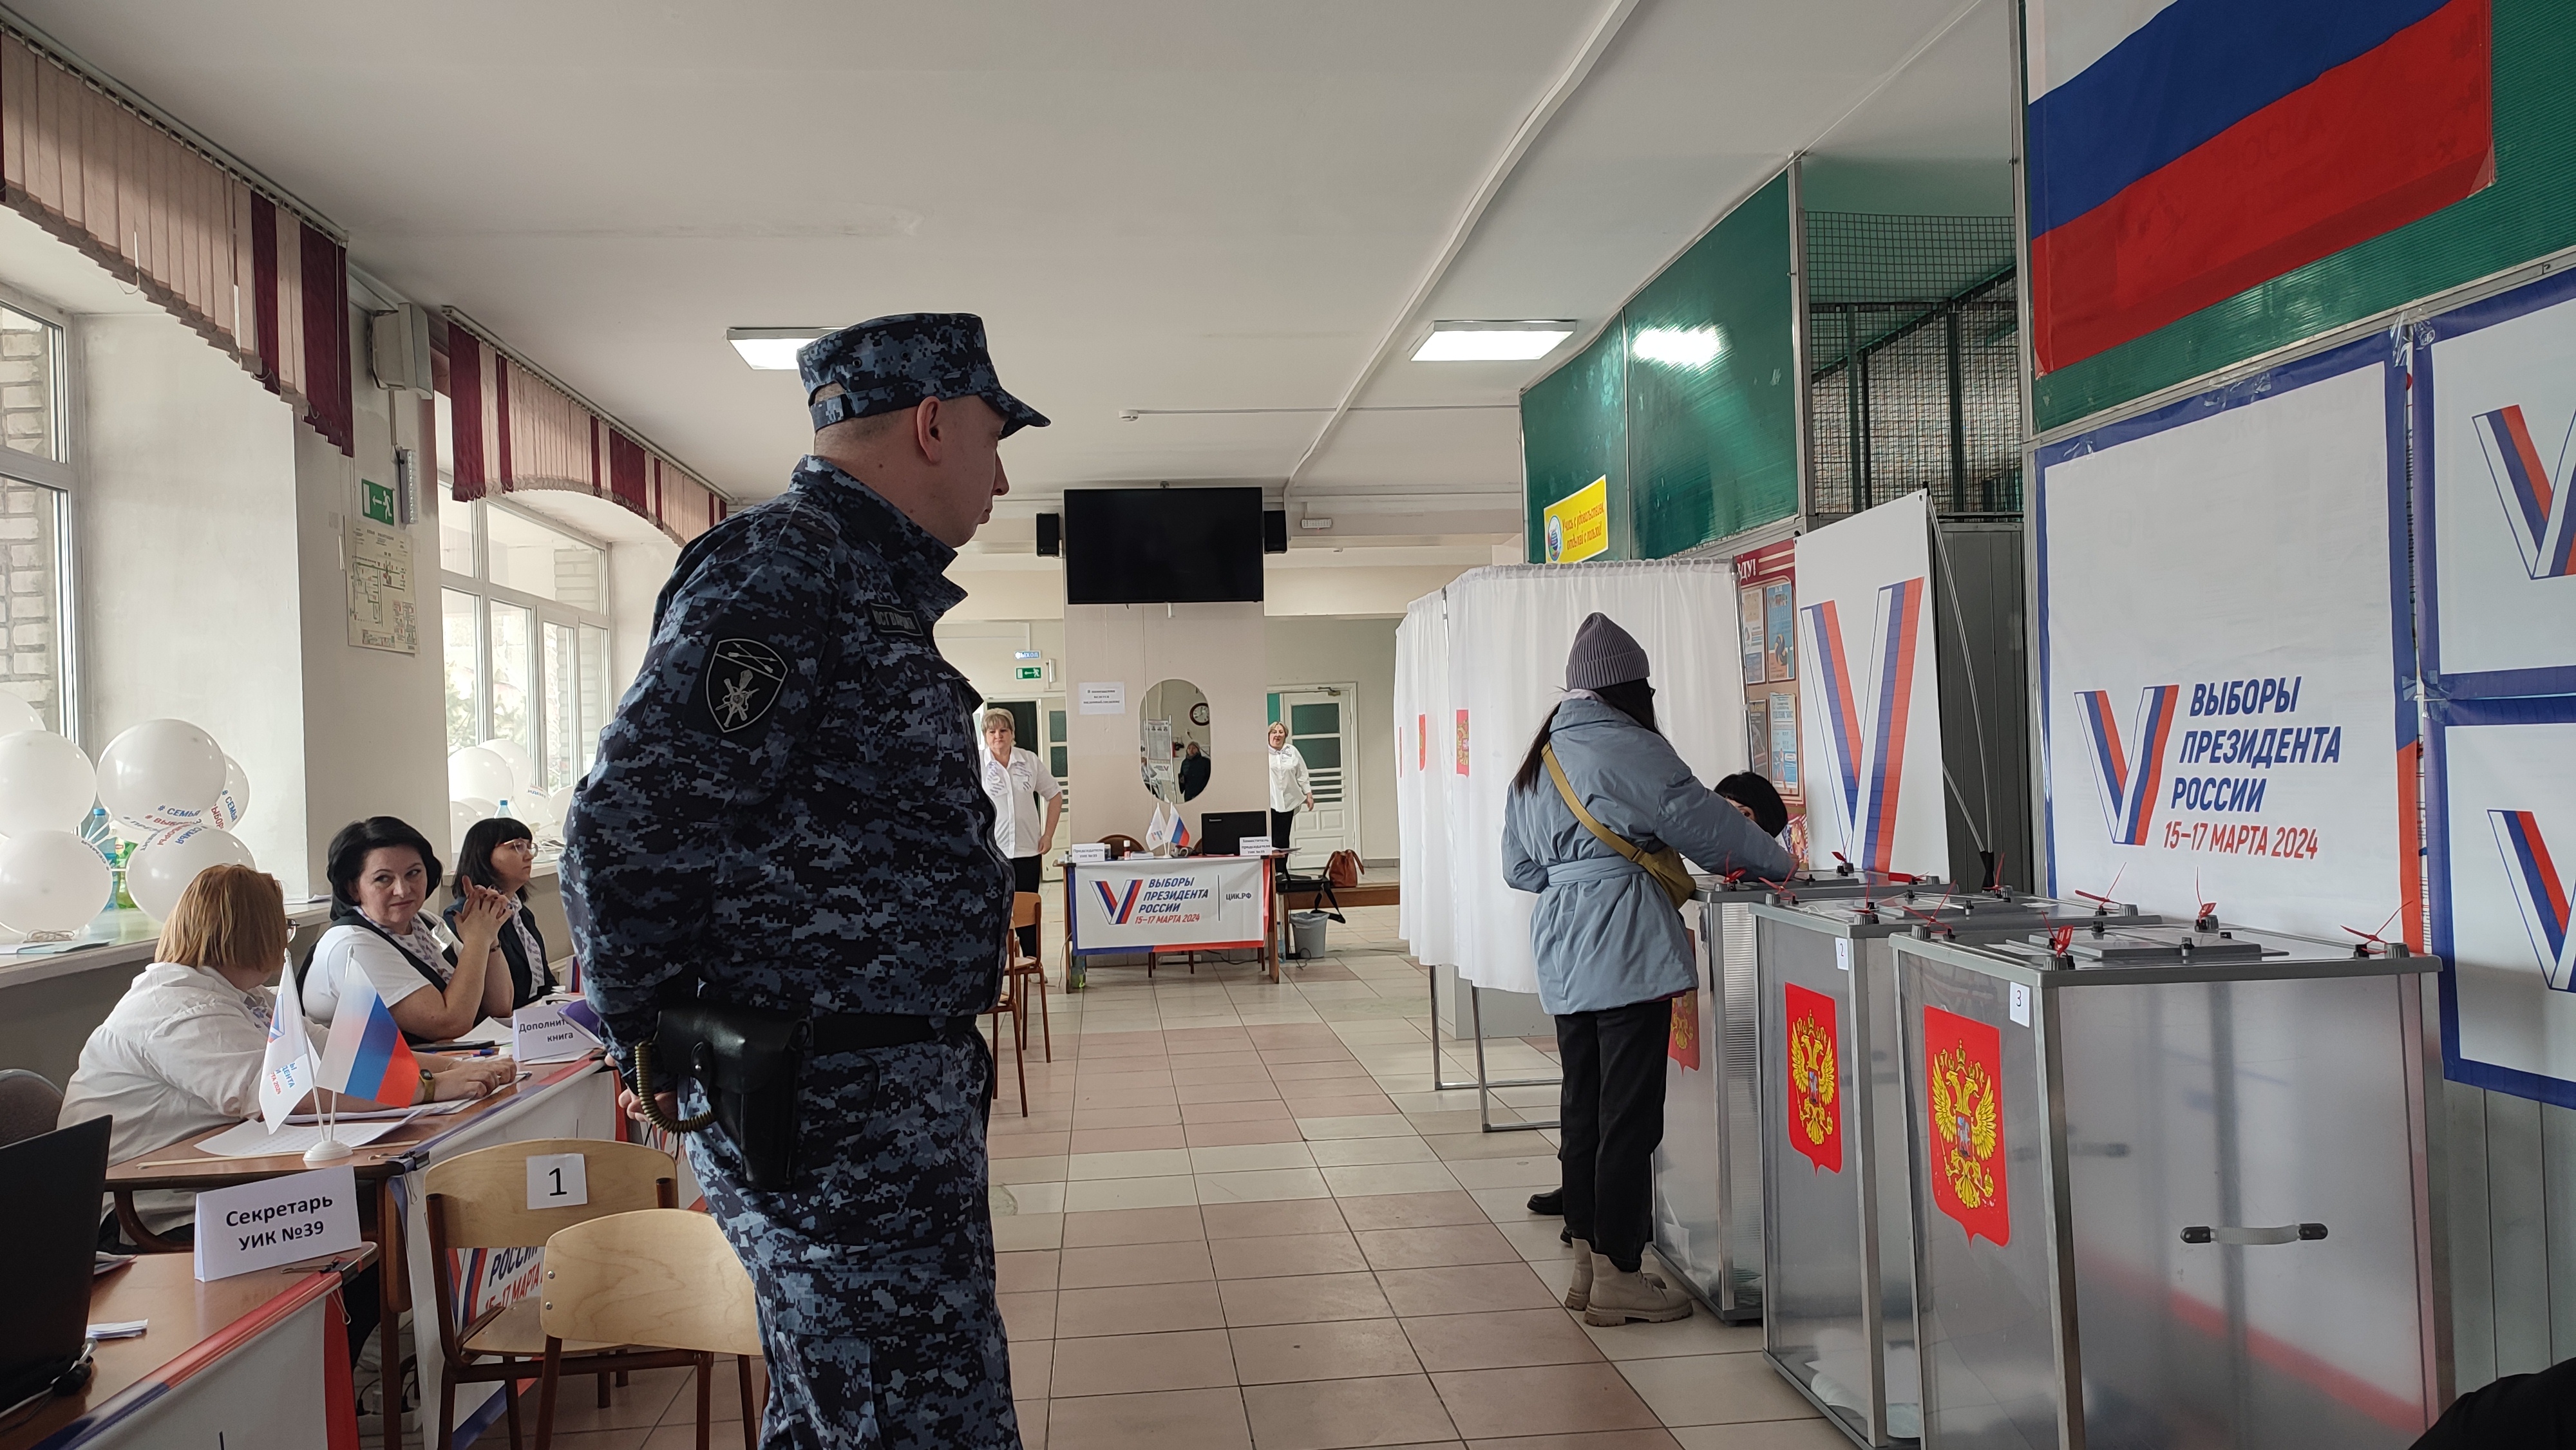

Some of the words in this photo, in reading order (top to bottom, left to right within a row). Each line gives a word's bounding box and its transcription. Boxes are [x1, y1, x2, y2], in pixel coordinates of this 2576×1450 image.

[2190, 676, 2302, 717] ВЫБОРЫ
[2179, 726, 2342, 769] ПРЕЗИДЕНТА
[2171, 777, 2267, 813] РОССИИ
[167, 807, 201, 817] СЕМЬЯ
[211, 804, 224, 829] ЫБОР
[2210, 824, 2268, 856] МАРТА
[2271, 827, 2318, 860] 2024
[1148, 877, 1195, 889] ВЫБОРЫ
[1143, 889, 1209, 901] ПРЕЗИДЕНТА
[1226, 892, 1252, 901] ЦИК.РФ
[1139, 903, 1181, 913] РОССИИ
[1156, 914, 1180, 923] МАРТА
[1182, 913, 1200, 922] 2024
[1840, 943, 1844, 957] 2
[2016, 990, 2022, 1007] 3
[547, 1032, 573, 1042] книга
[549, 1167, 567, 1196] 1
[226, 1196, 334, 1227] Секретарь
[238, 1230, 277, 1251] УИК
[282, 1221, 325, 1242] №39
[511, 1262, 540, 1304] МАРТА
